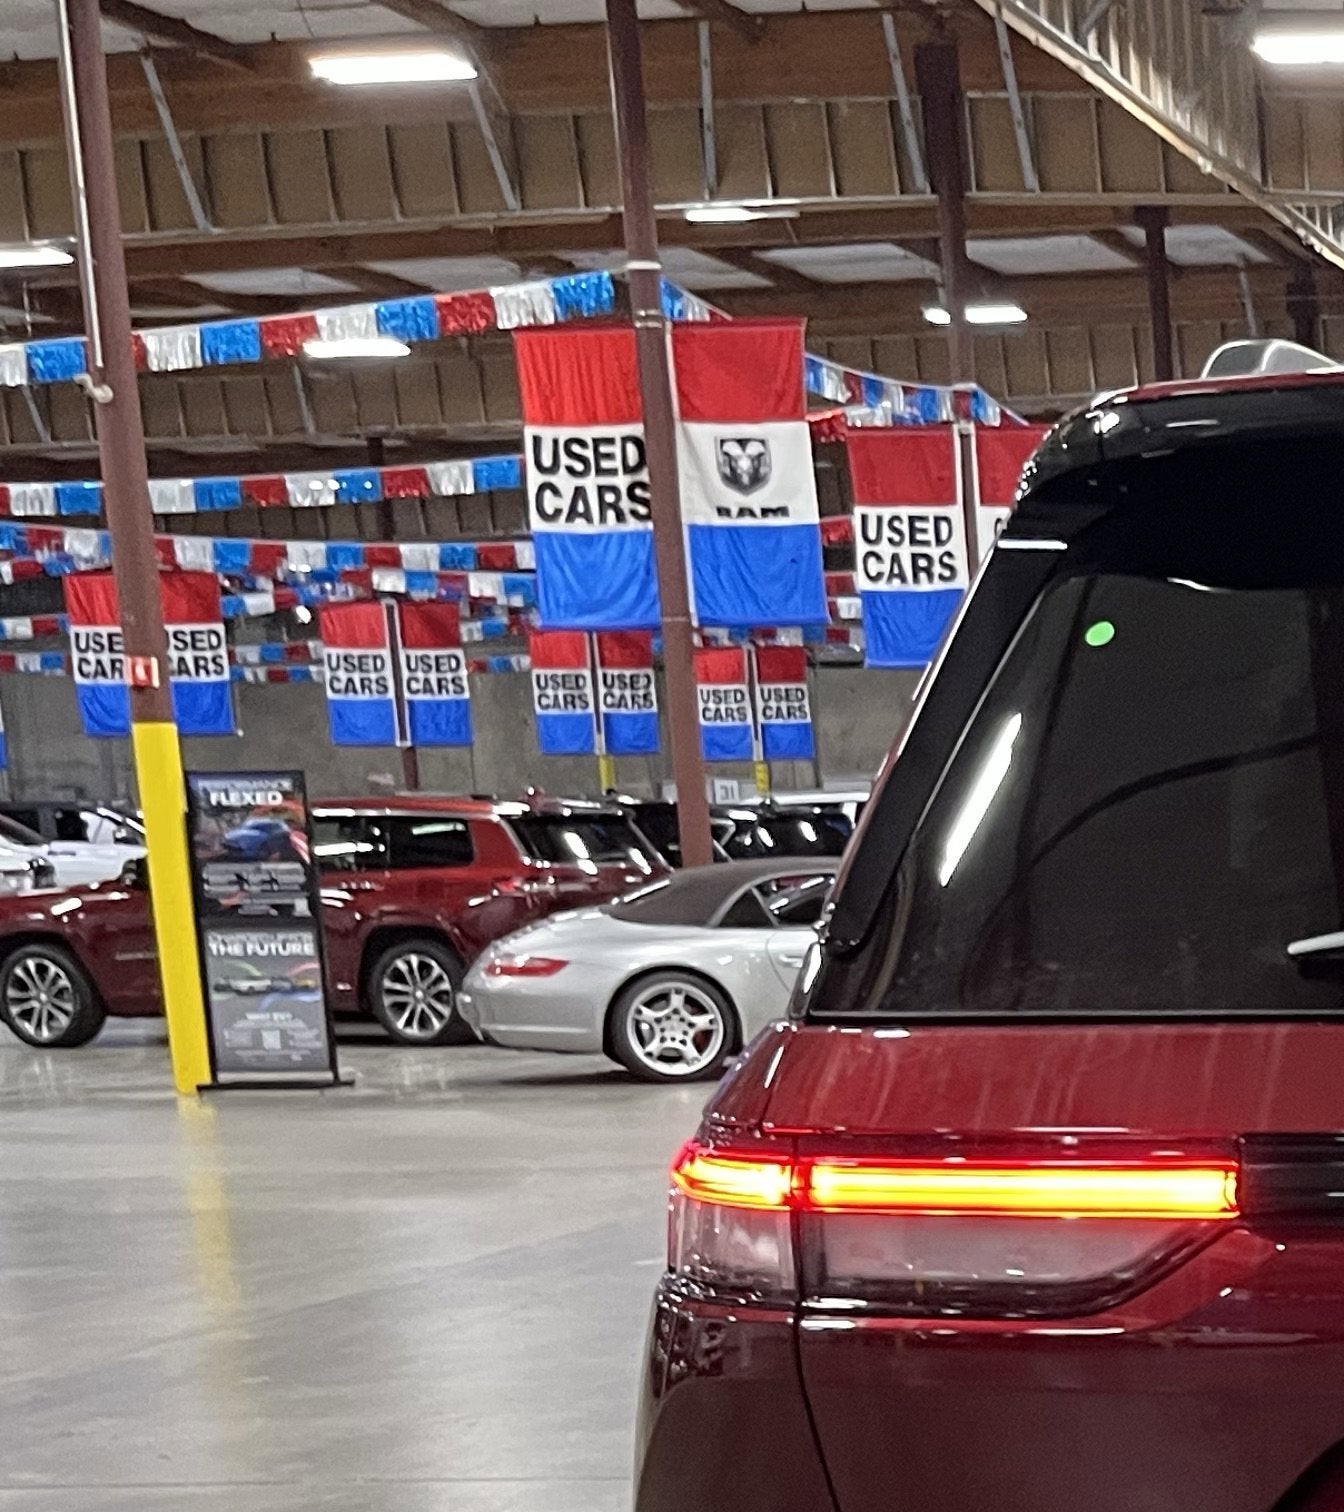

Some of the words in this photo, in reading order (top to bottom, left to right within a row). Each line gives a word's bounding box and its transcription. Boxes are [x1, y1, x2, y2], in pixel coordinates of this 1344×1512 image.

[532, 435, 647, 478] USED
[535, 481, 652, 525] CARS
[861, 513, 954, 548] USED
[862, 550, 957, 586] CARS
[75, 631, 123, 654] USE
[167, 630, 222, 652] SED
[78, 656, 123, 680] CAR
[169, 654, 225, 677] ARS
[326, 653, 386, 674] USED
[405, 653, 461, 674] USED
[328, 675, 389, 696] CARS
[406, 675, 466, 695] CARS
[535, 673, 587, 691] USED
[602, 672, 652, 691] USED
[537, 692, 590, 710] CARS
[603, 691, 654, 710] CARS
[699, 688, 745, 704] USED
[760, 687, 806, 703] USED
[701, 705, 748, 722] CARS
[761, 703, 808, 720] CARS
[208, 942, 245, 957] THE
[246, 942, 315, 957] FUTURE
